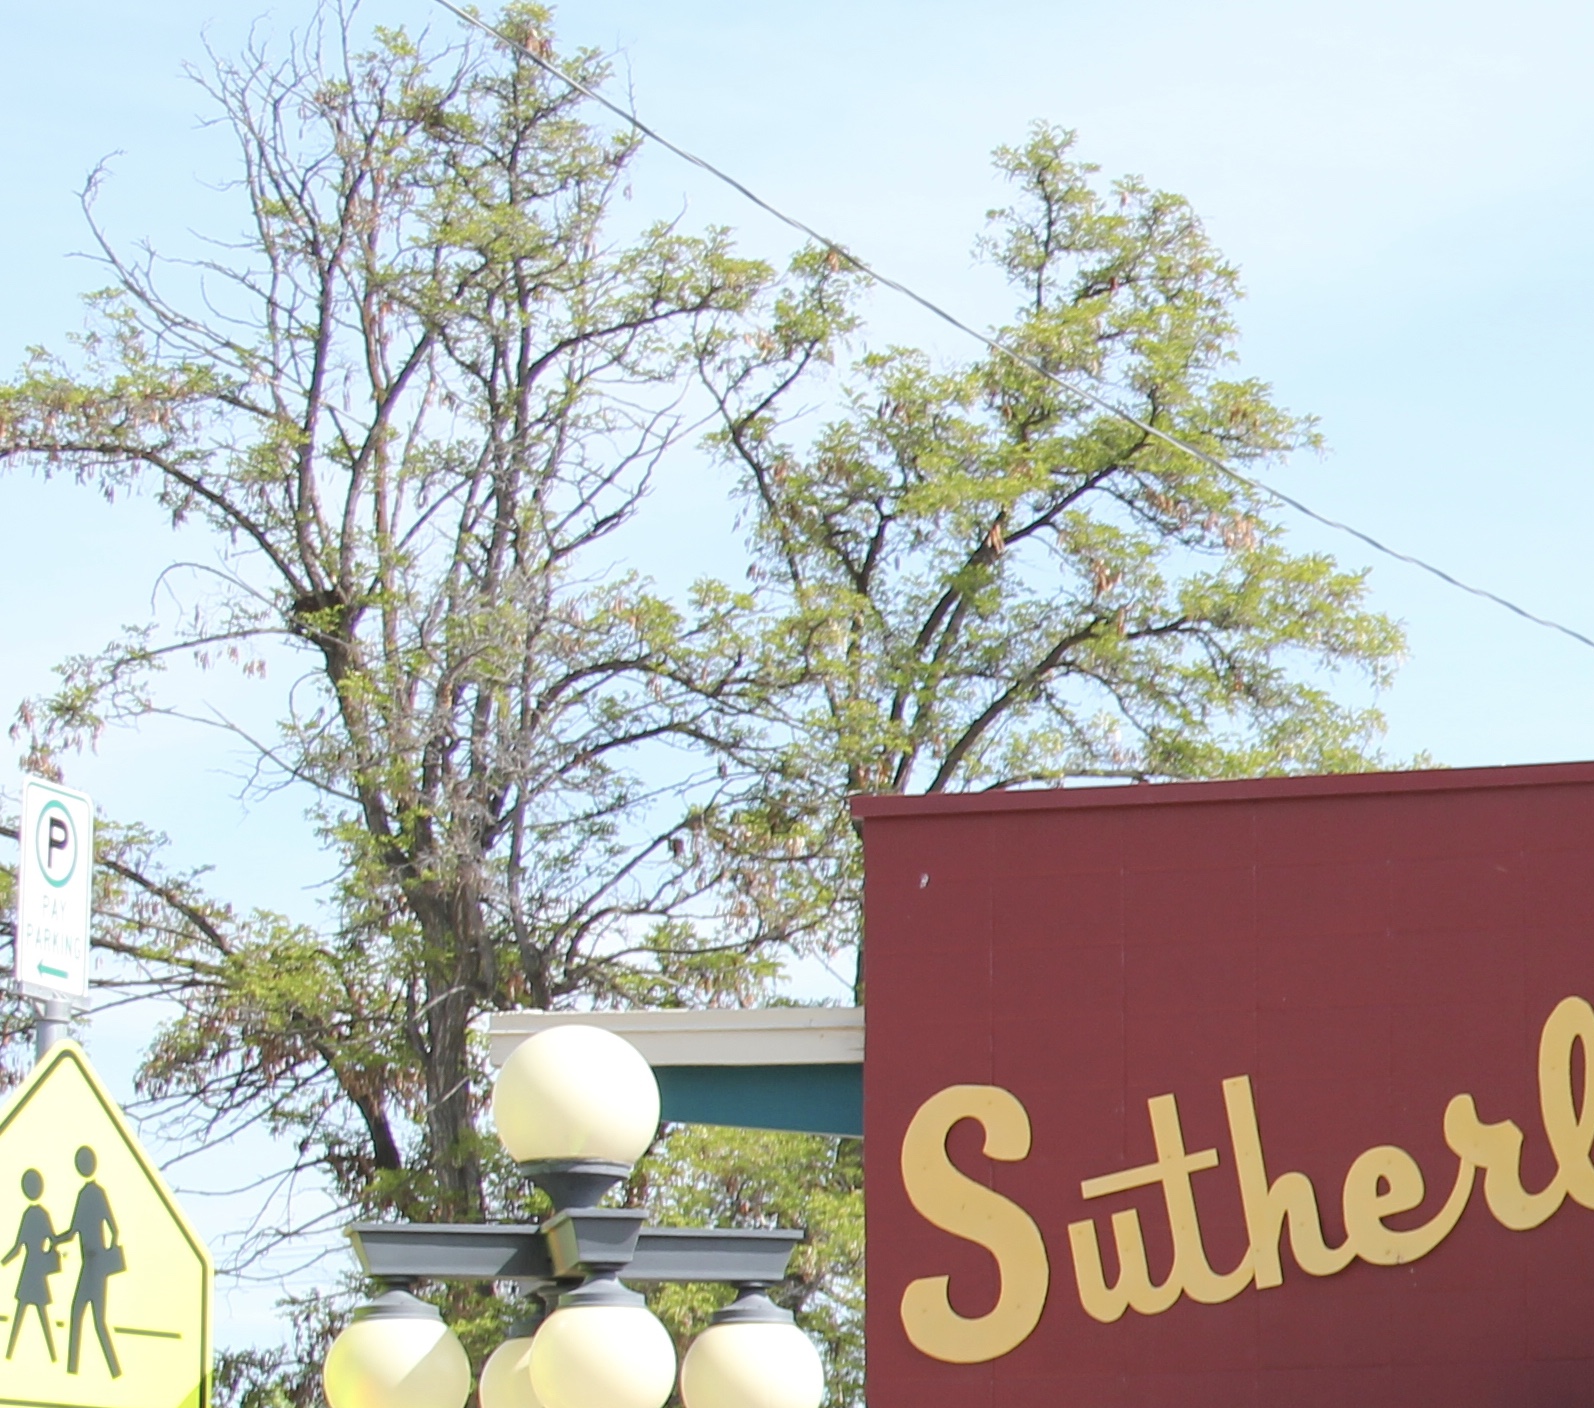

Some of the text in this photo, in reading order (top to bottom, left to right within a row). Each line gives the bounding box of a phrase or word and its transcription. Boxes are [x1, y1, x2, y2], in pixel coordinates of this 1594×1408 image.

[47, 815, 69, 869] P
[42, 894, 67, 921] PAY
[27, 923, 81, 960] PARKING
